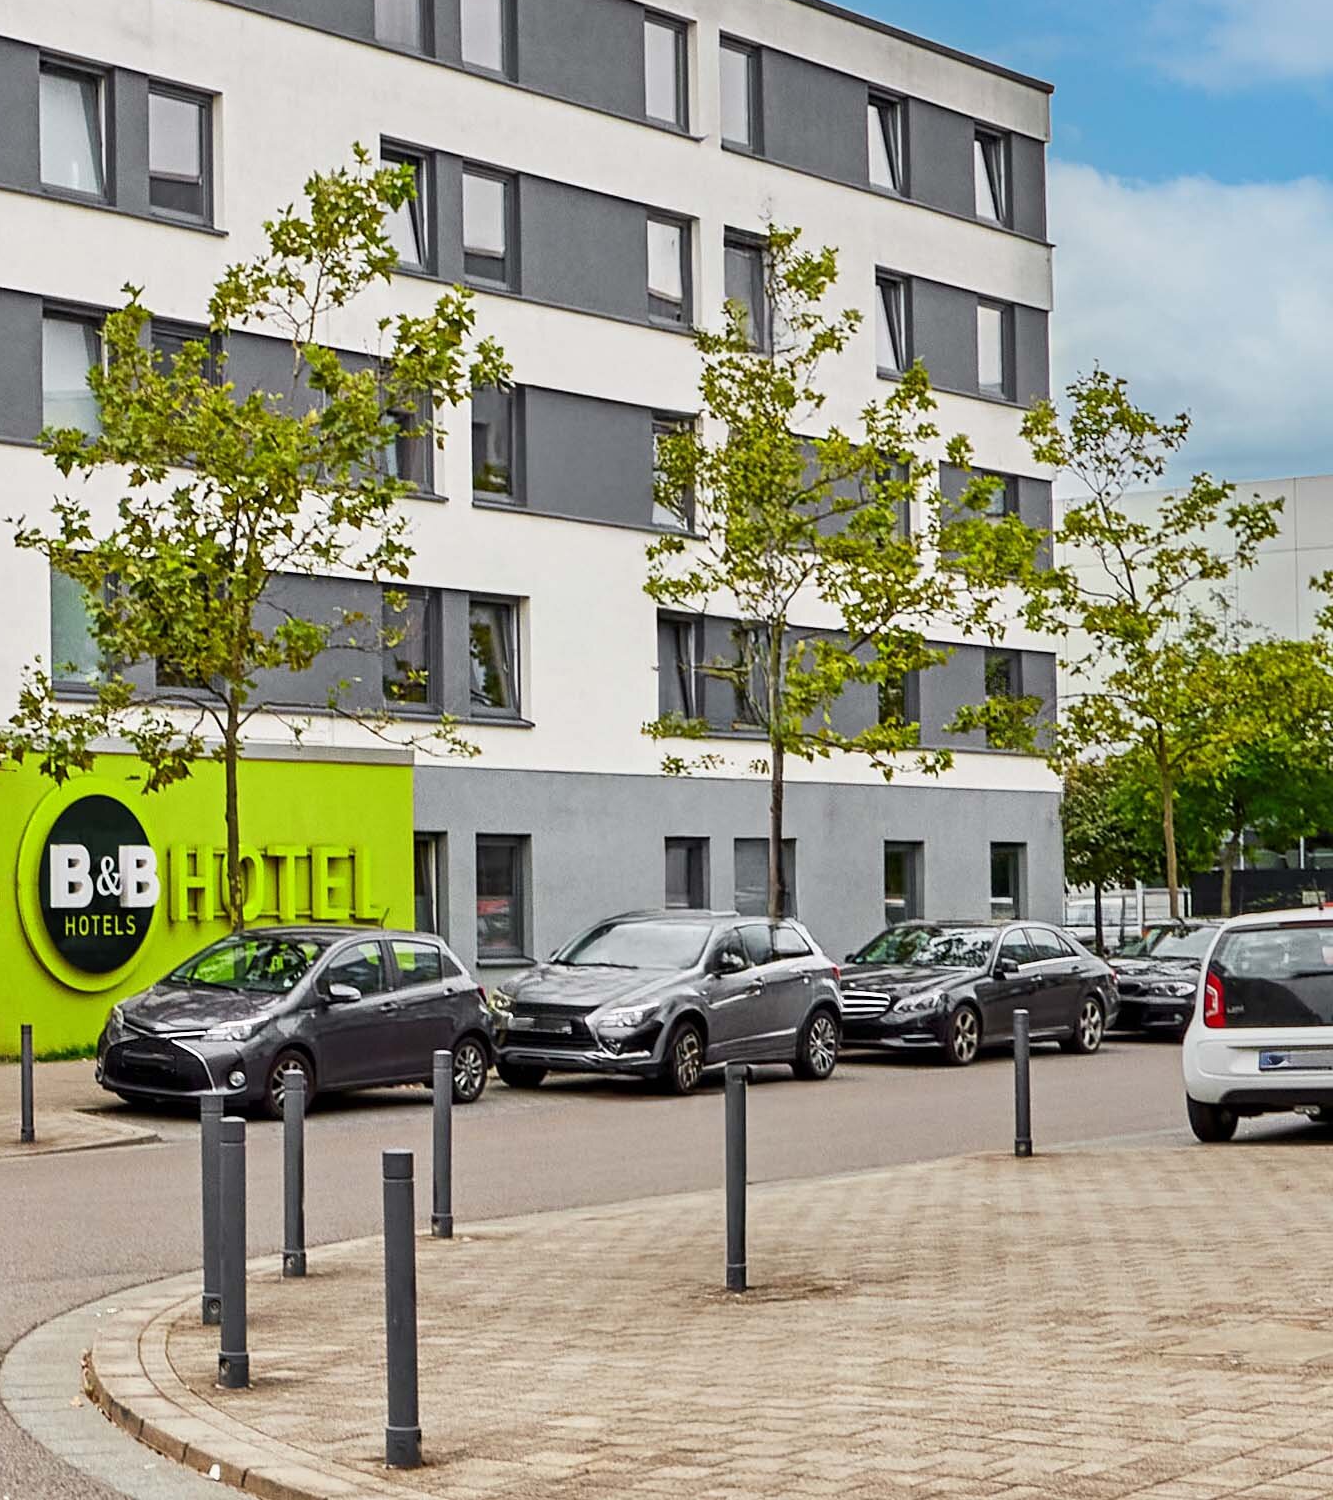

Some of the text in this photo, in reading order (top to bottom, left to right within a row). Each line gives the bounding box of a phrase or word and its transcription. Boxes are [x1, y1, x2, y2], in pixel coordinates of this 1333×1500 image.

[50, 844, 161, 908] B&B
[170, 844, 383, 921] HOTEL
[65, 915, 136, 936] HOTELS
